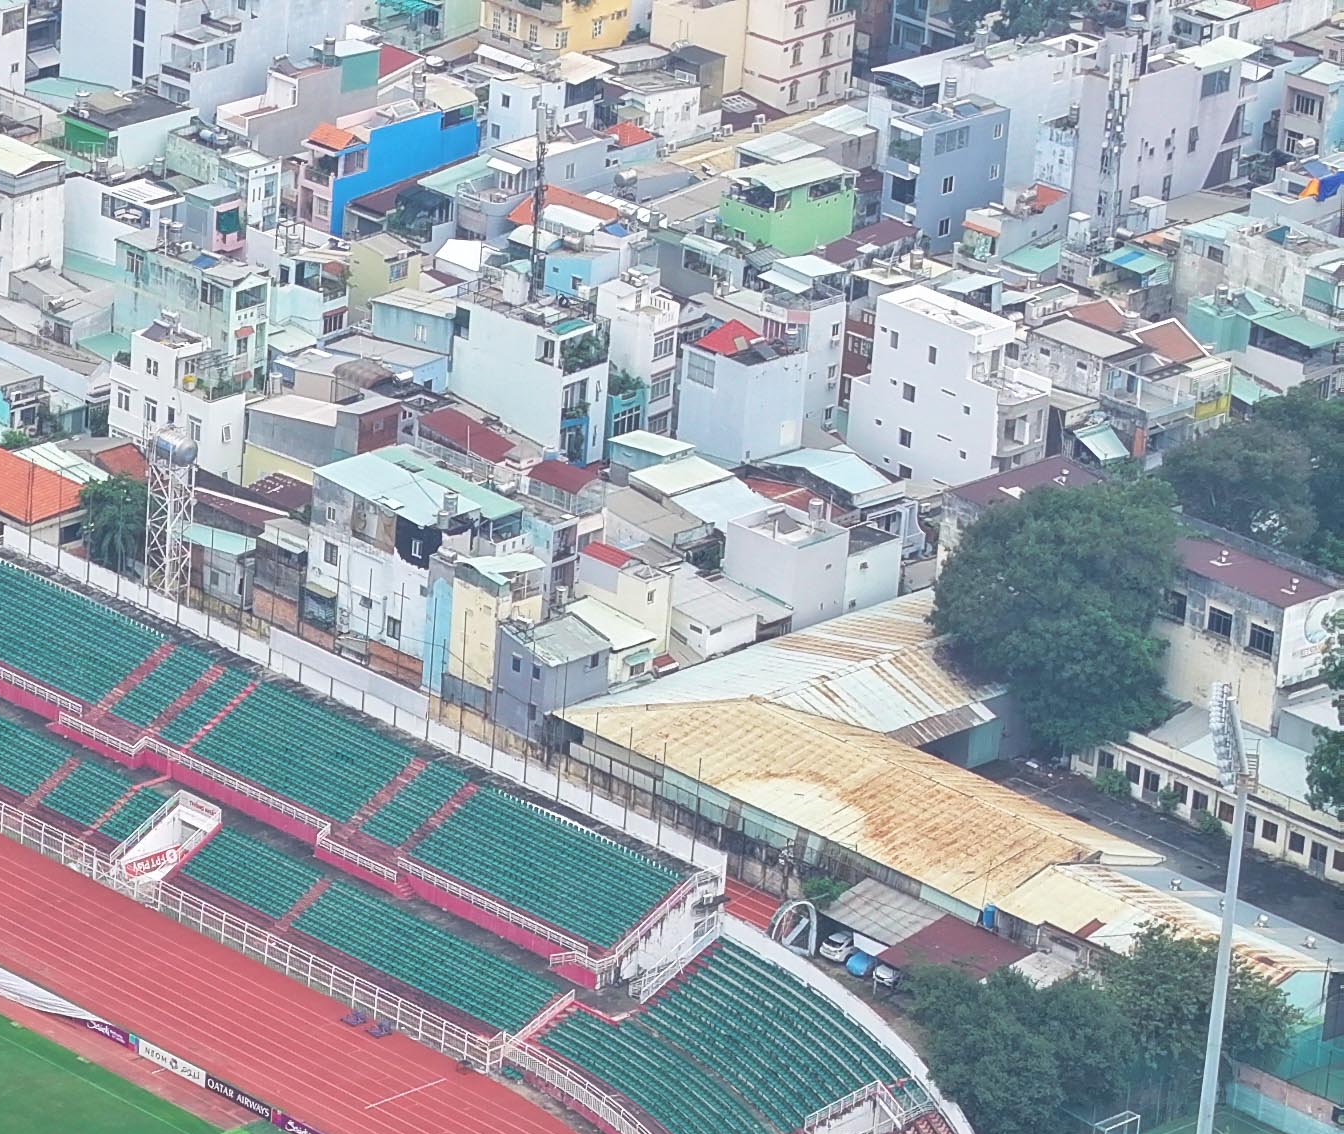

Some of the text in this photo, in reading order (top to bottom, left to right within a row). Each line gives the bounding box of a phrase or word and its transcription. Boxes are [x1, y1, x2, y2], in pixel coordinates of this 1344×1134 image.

[145, 1046, 167, 1063] NEOM
[207, 1078, 269, 1117] QATAR AIRWAYS
